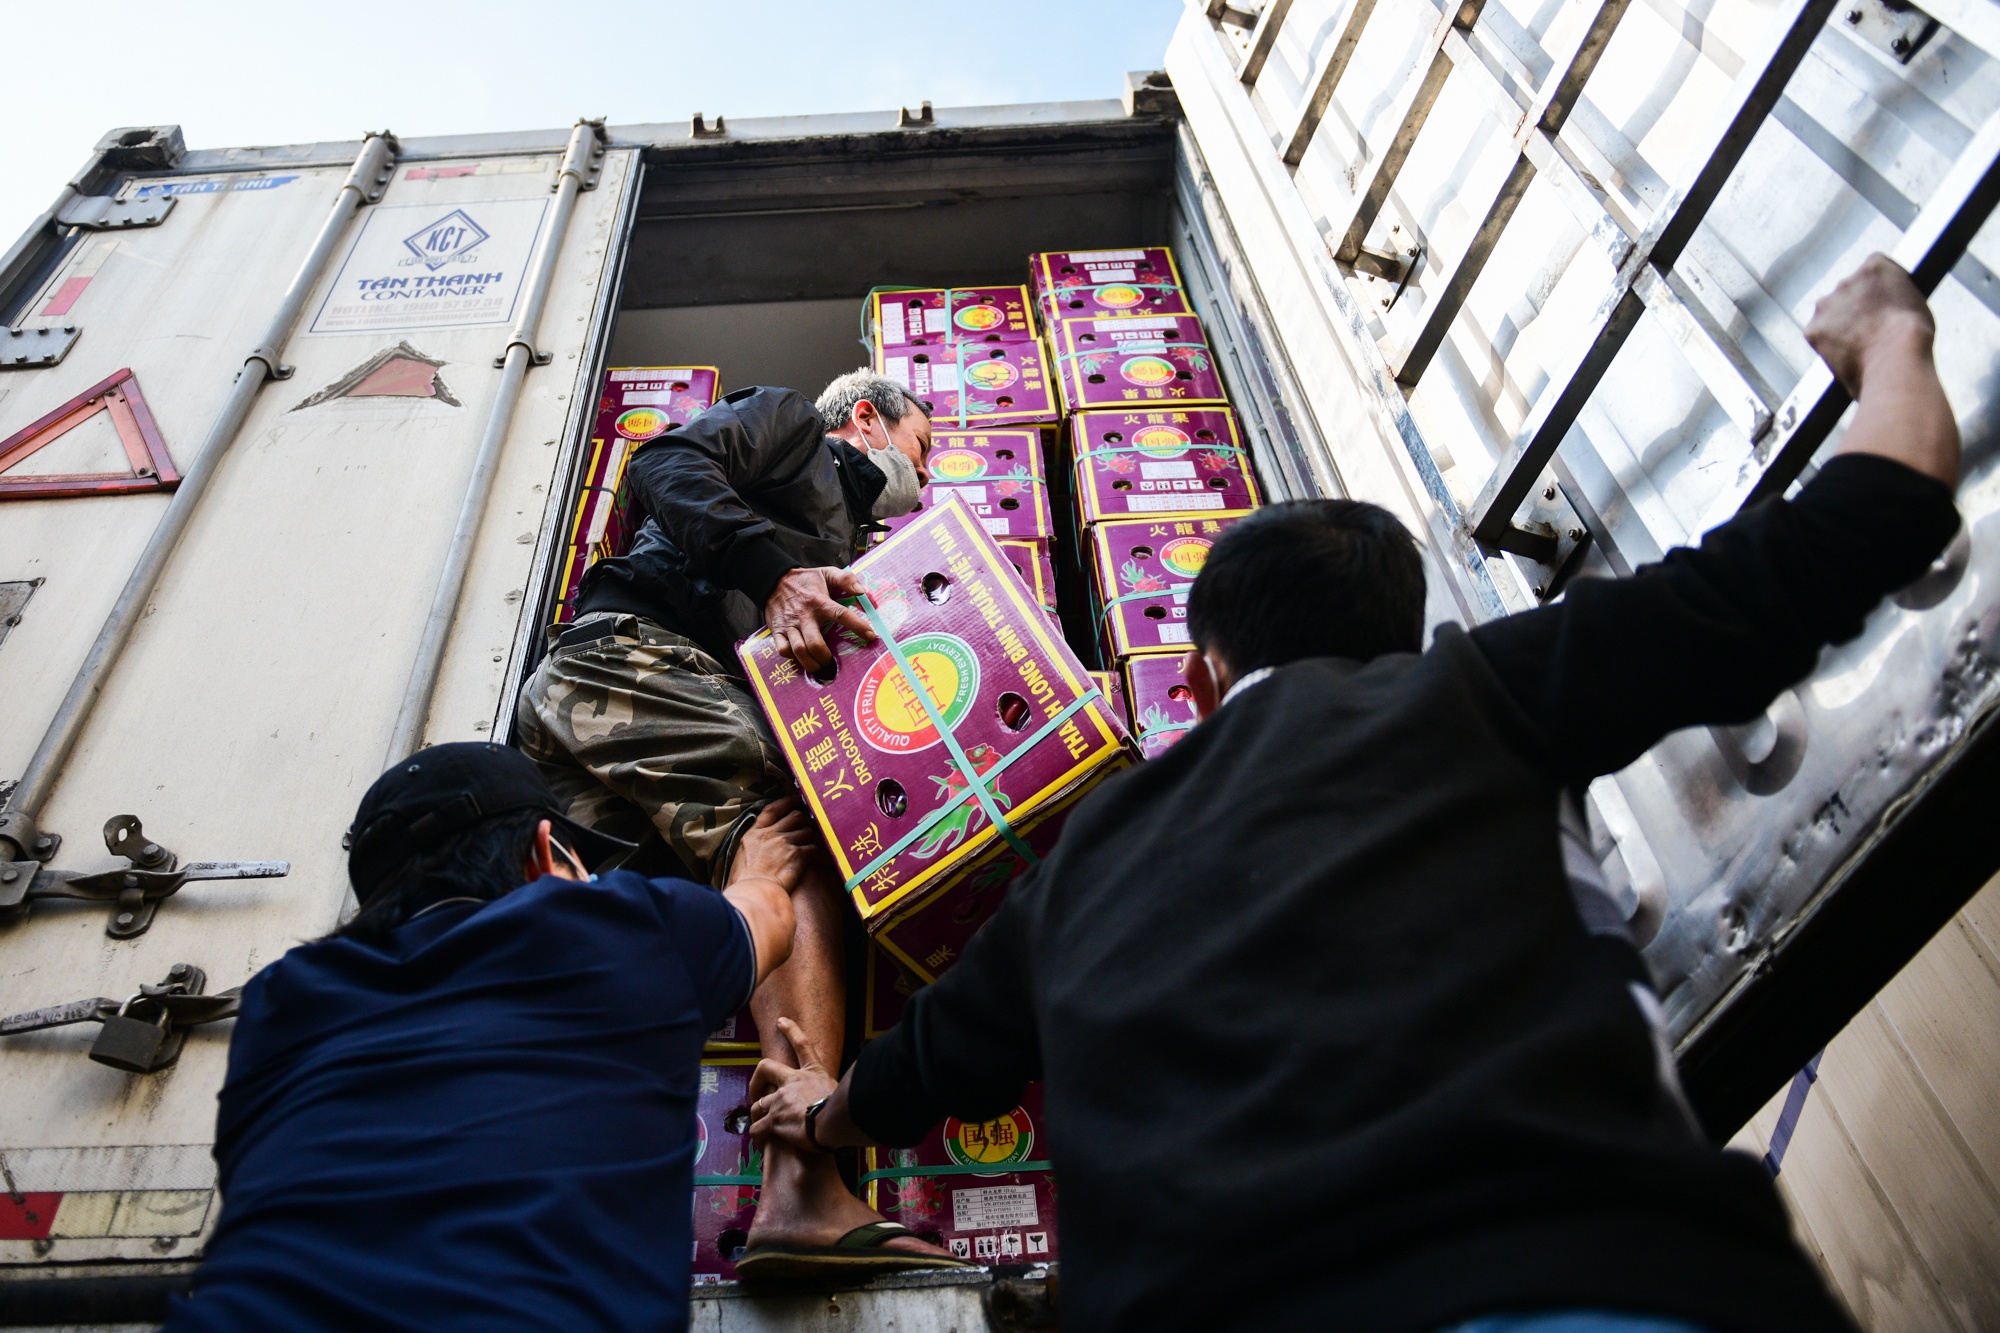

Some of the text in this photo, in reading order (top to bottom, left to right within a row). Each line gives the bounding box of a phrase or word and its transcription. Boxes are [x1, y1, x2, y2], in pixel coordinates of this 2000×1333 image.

[213, 179, 273, 191] TANH
[425, 226, 467, 253] KCT
[358, 272, 503, 290] TÂN THANH
[360, 286, 486, 301] CONTAINER
[402, 301, 439, 312] 1900
[1166, 539, 1192, 551] QUALITY
[929, 522, 1089, 760] THAH LONG BÌNH THUẬN VIỆT NAM
[926, 642, 969, 703] FRESH EVERYDAY
[862, 676, 910, 747] QUALITY FRUIT
[819, 693, 873, 786] DRAGON FRUIT
[790, 706, 855, 800] 火龍果
[963, 1123, 1015, 1149] 国强
